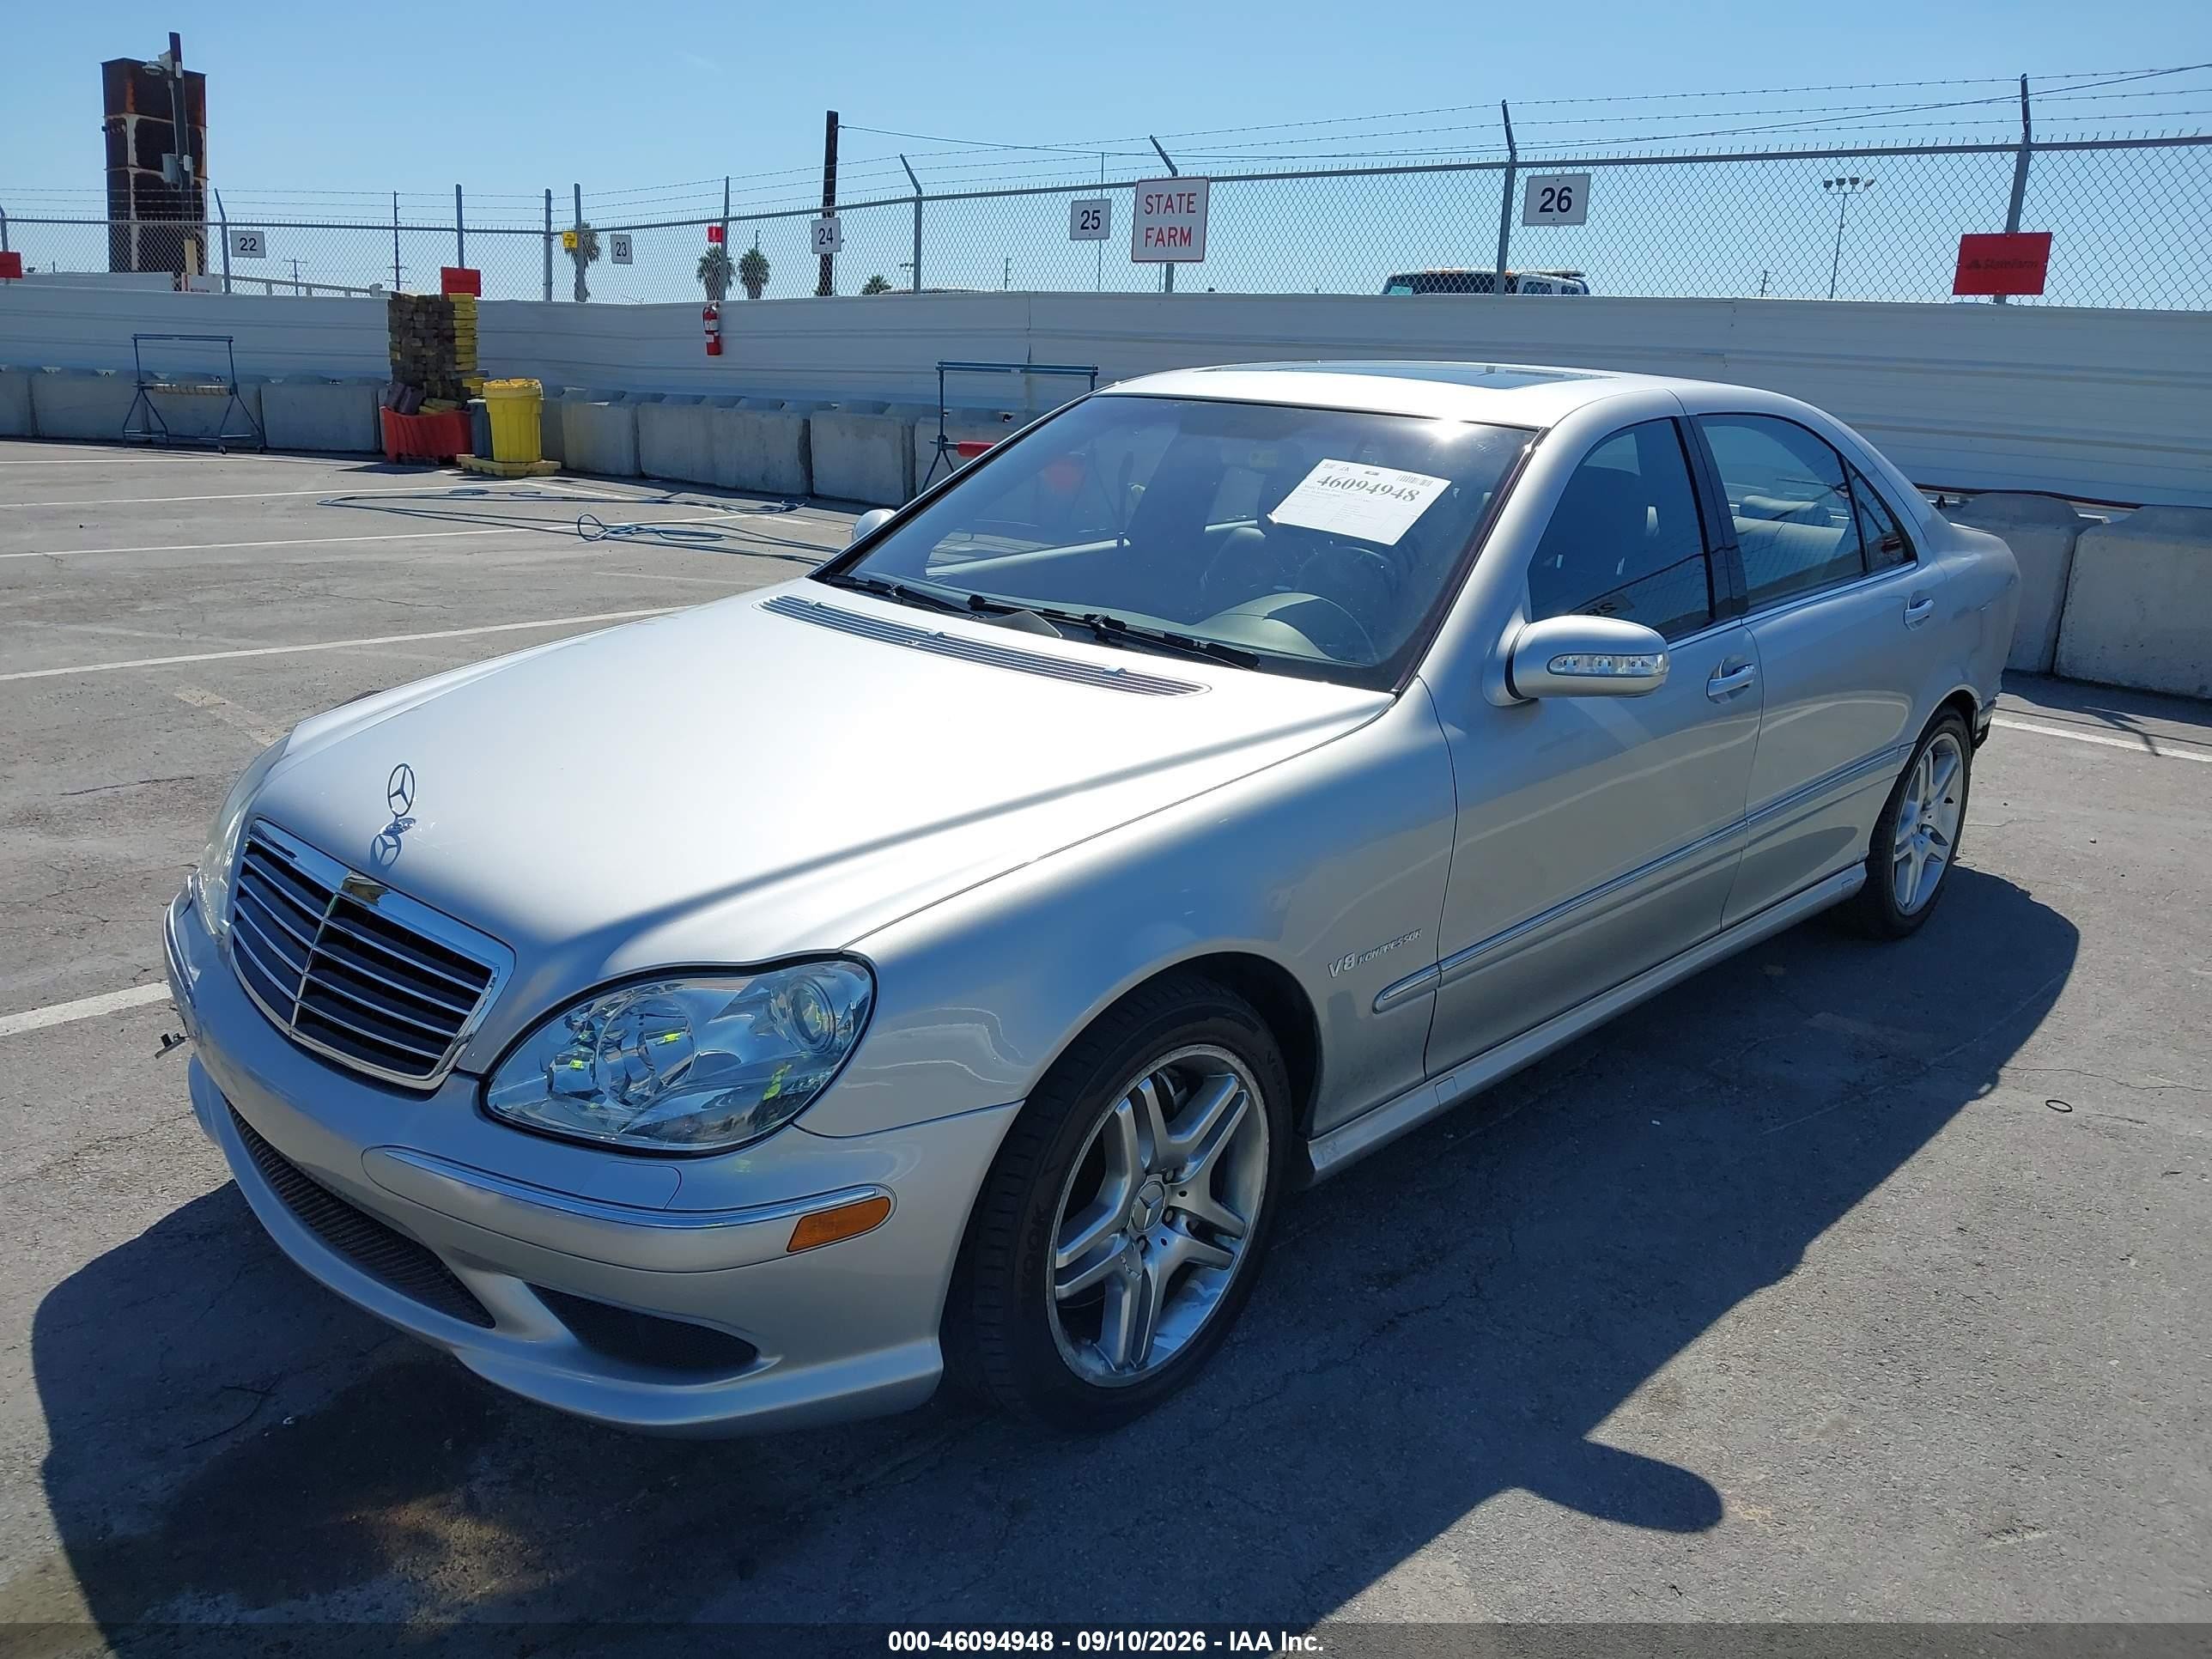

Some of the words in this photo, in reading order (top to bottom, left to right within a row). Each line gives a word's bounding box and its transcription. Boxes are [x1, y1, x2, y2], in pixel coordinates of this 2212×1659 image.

[1144, 192, 1197, 215] STATE
[1539, 186, 1573, 213] 26
[1080, 210, 1101, 230] 25
[240, 237, 257, 252] 22
[818, 227, 834, 245] 24
[1145, 227, 1192, 247] FARM
[616, 241, 628, 257] 23
[1316, 474, 1421, 502] 46094948
[1328, 951, 1356, 978] V8
